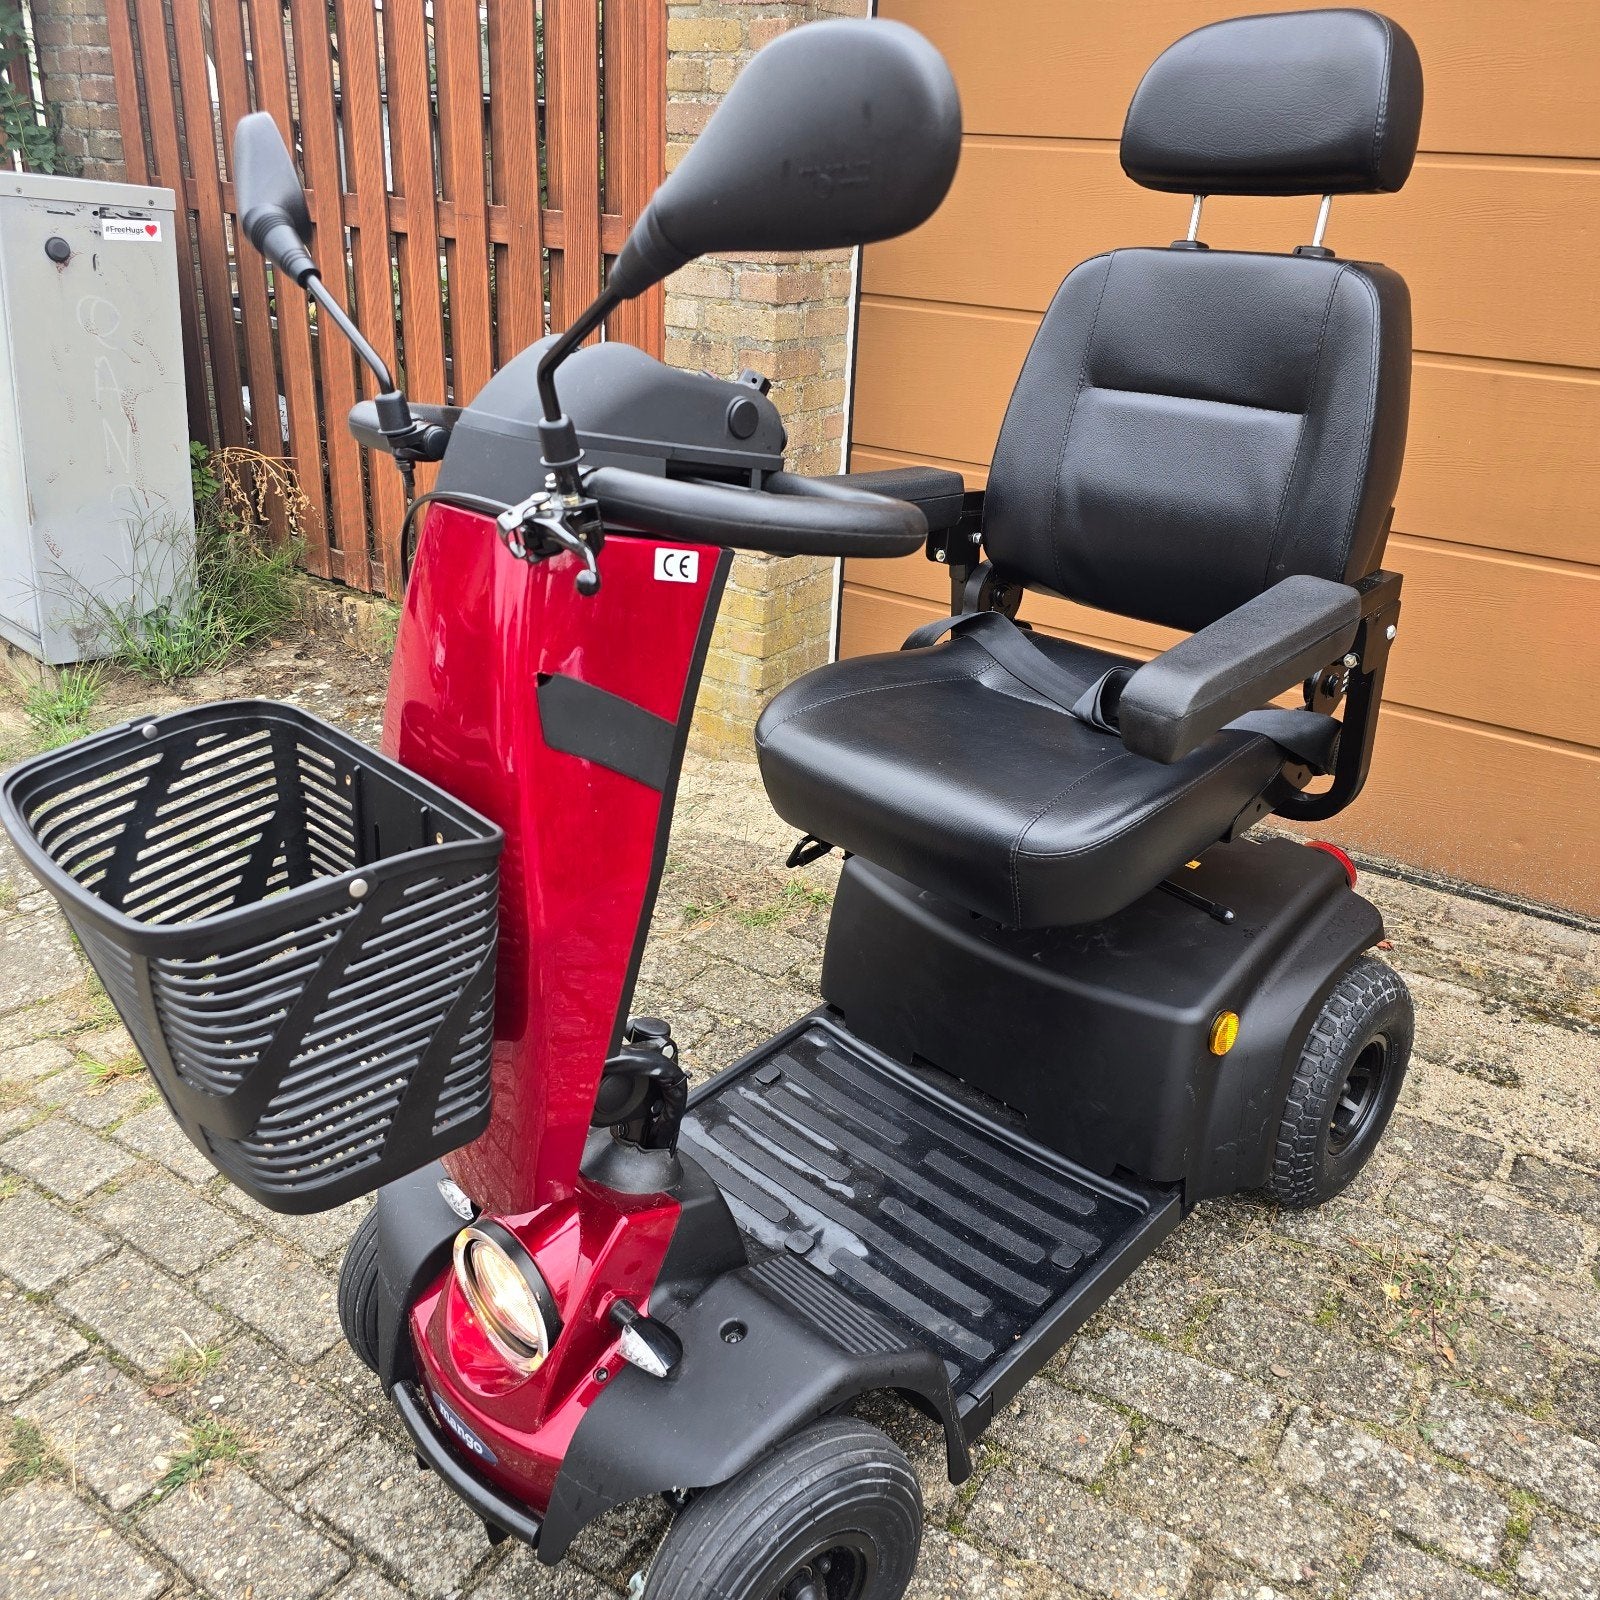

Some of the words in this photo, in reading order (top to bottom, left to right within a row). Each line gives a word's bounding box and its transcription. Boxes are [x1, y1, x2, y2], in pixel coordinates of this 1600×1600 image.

[105, 225, 144, 236] #FreeHugs
[663, 553, 690, 579] CE
[439, 1402, 483, 1455] mango
